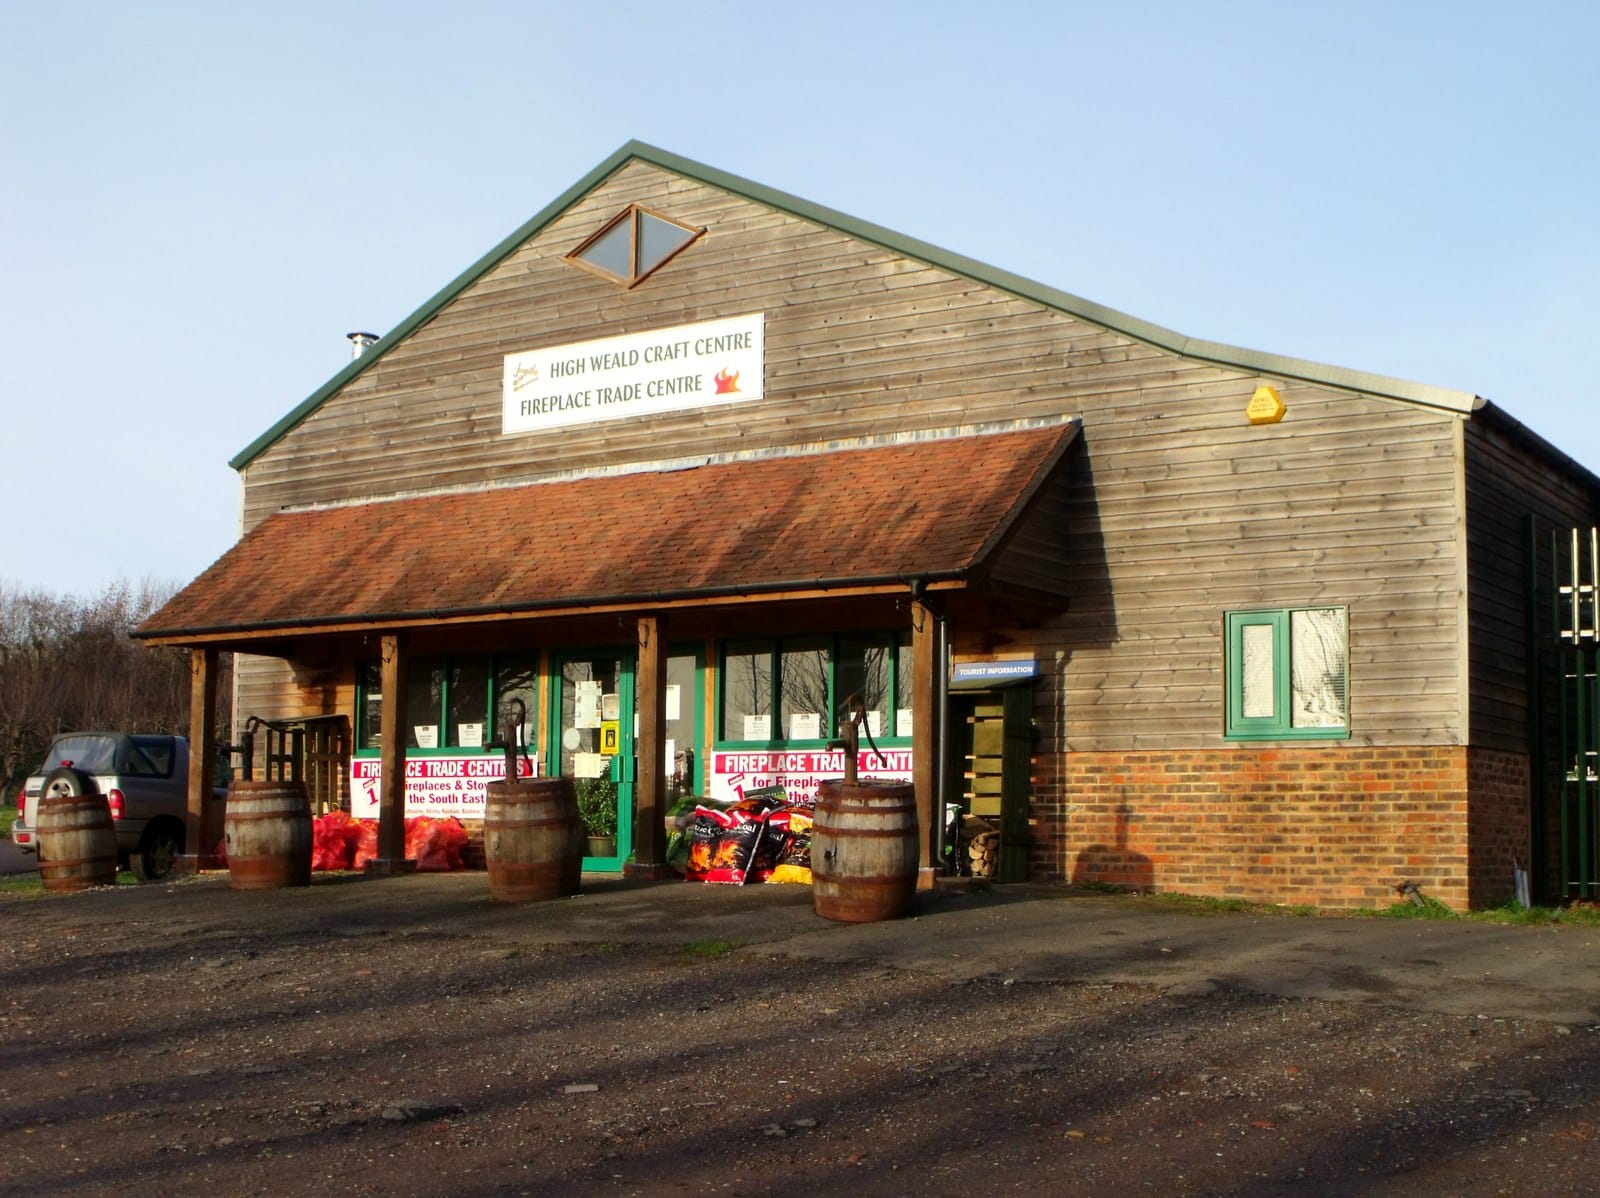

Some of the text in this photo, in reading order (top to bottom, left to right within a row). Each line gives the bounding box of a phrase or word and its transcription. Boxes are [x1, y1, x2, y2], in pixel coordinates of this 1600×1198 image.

[550, 358, 585, 379] HIGH
[590, 350, 639, 372] WEALD
[644, 341, 690, 364] CRAFT
[695, 331, 753, 356] CENTRE
[520, 374, 703, 416] FIREPLACE TRADE CENTRE
[960, 666, 1033, 676] TOURIST INFORMATION
[426, 760, 465, 777] TRADE
[725, 754, 806, 773] FIREPLACE
[404, 780, 451, 793] ireplaces
[454, 780, 463, 791] &
[752, 776, 771, 788] for
[409, 793, 485, 804] the South East
[788, 790, 809, 803] the
